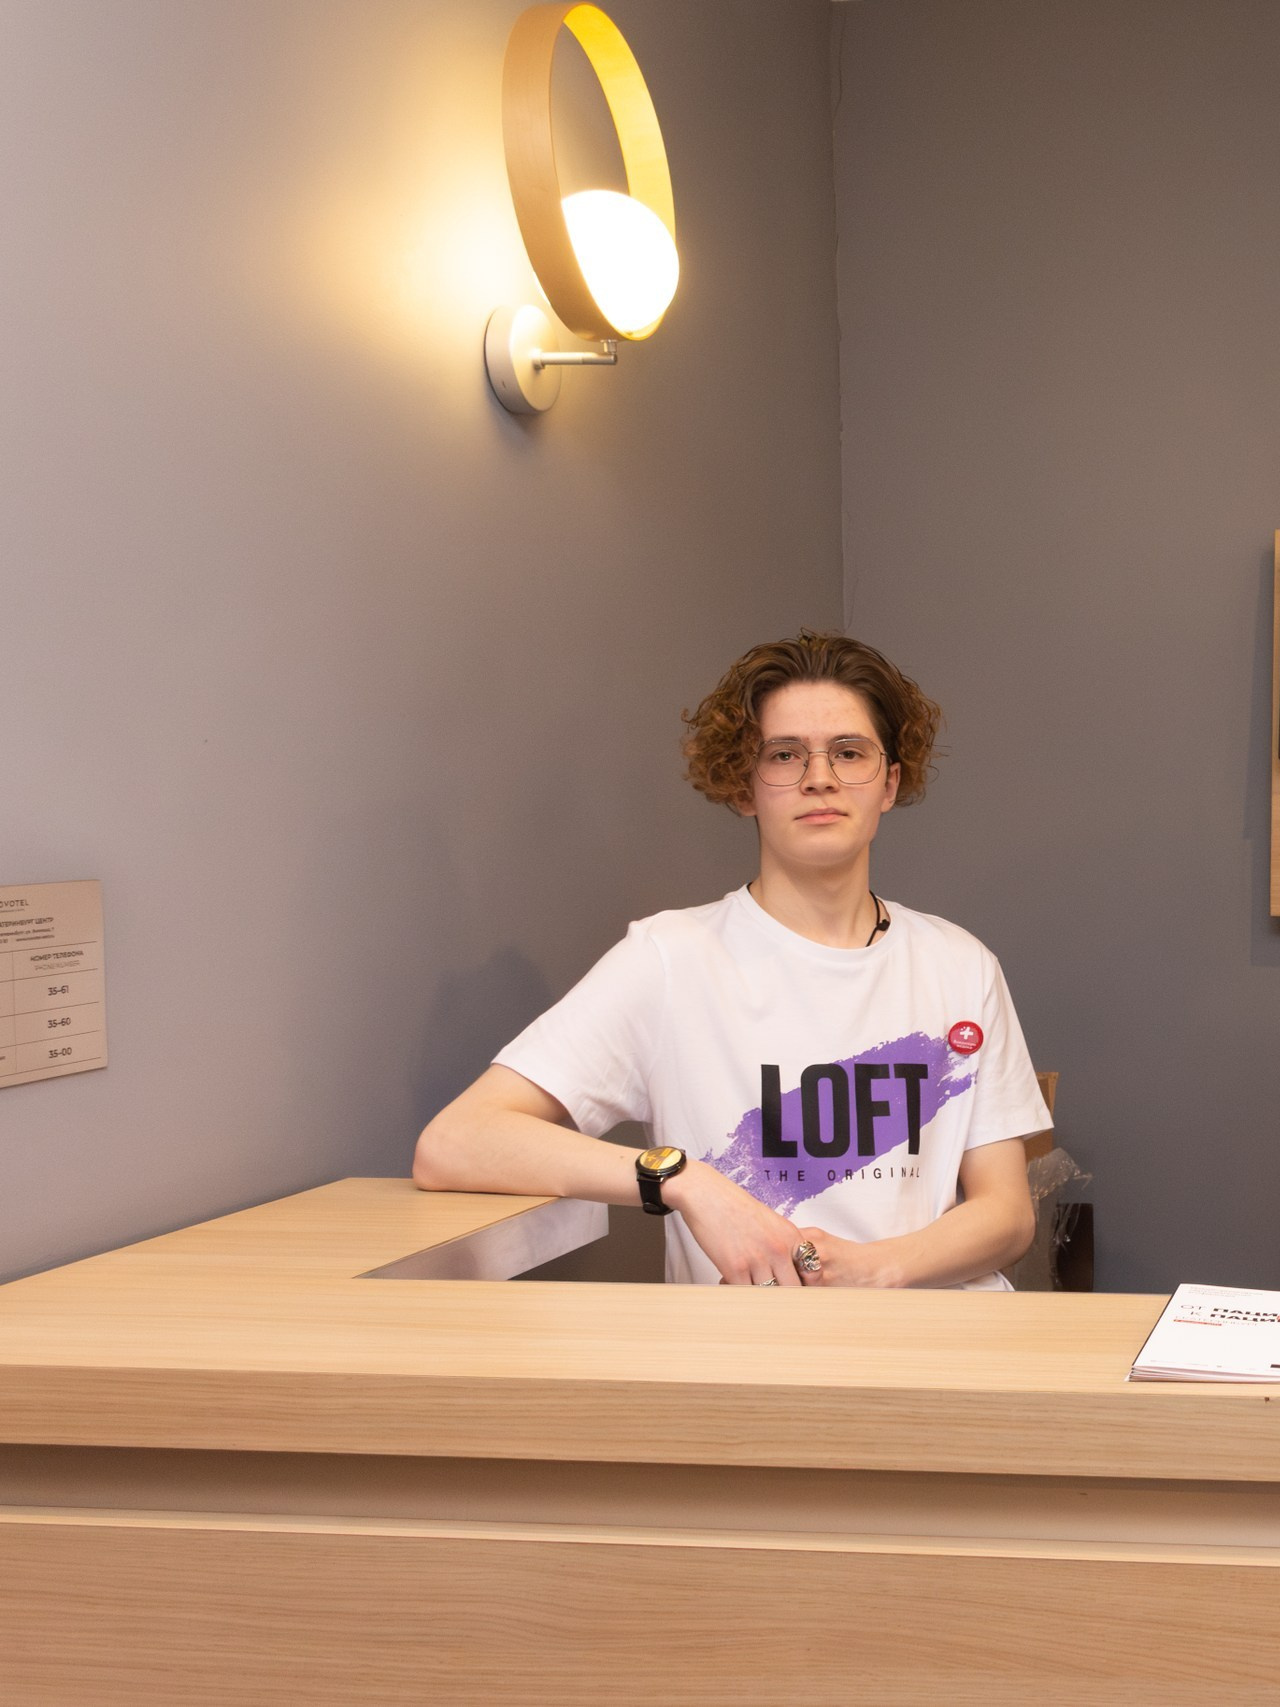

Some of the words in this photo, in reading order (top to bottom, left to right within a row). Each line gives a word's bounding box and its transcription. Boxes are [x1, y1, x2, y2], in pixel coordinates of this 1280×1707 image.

[761, 1063, 928, 1158] LOFT
[765, 1170, 805, 1182] THE
[827, 1166, 920, 1181] ORIGINAL
